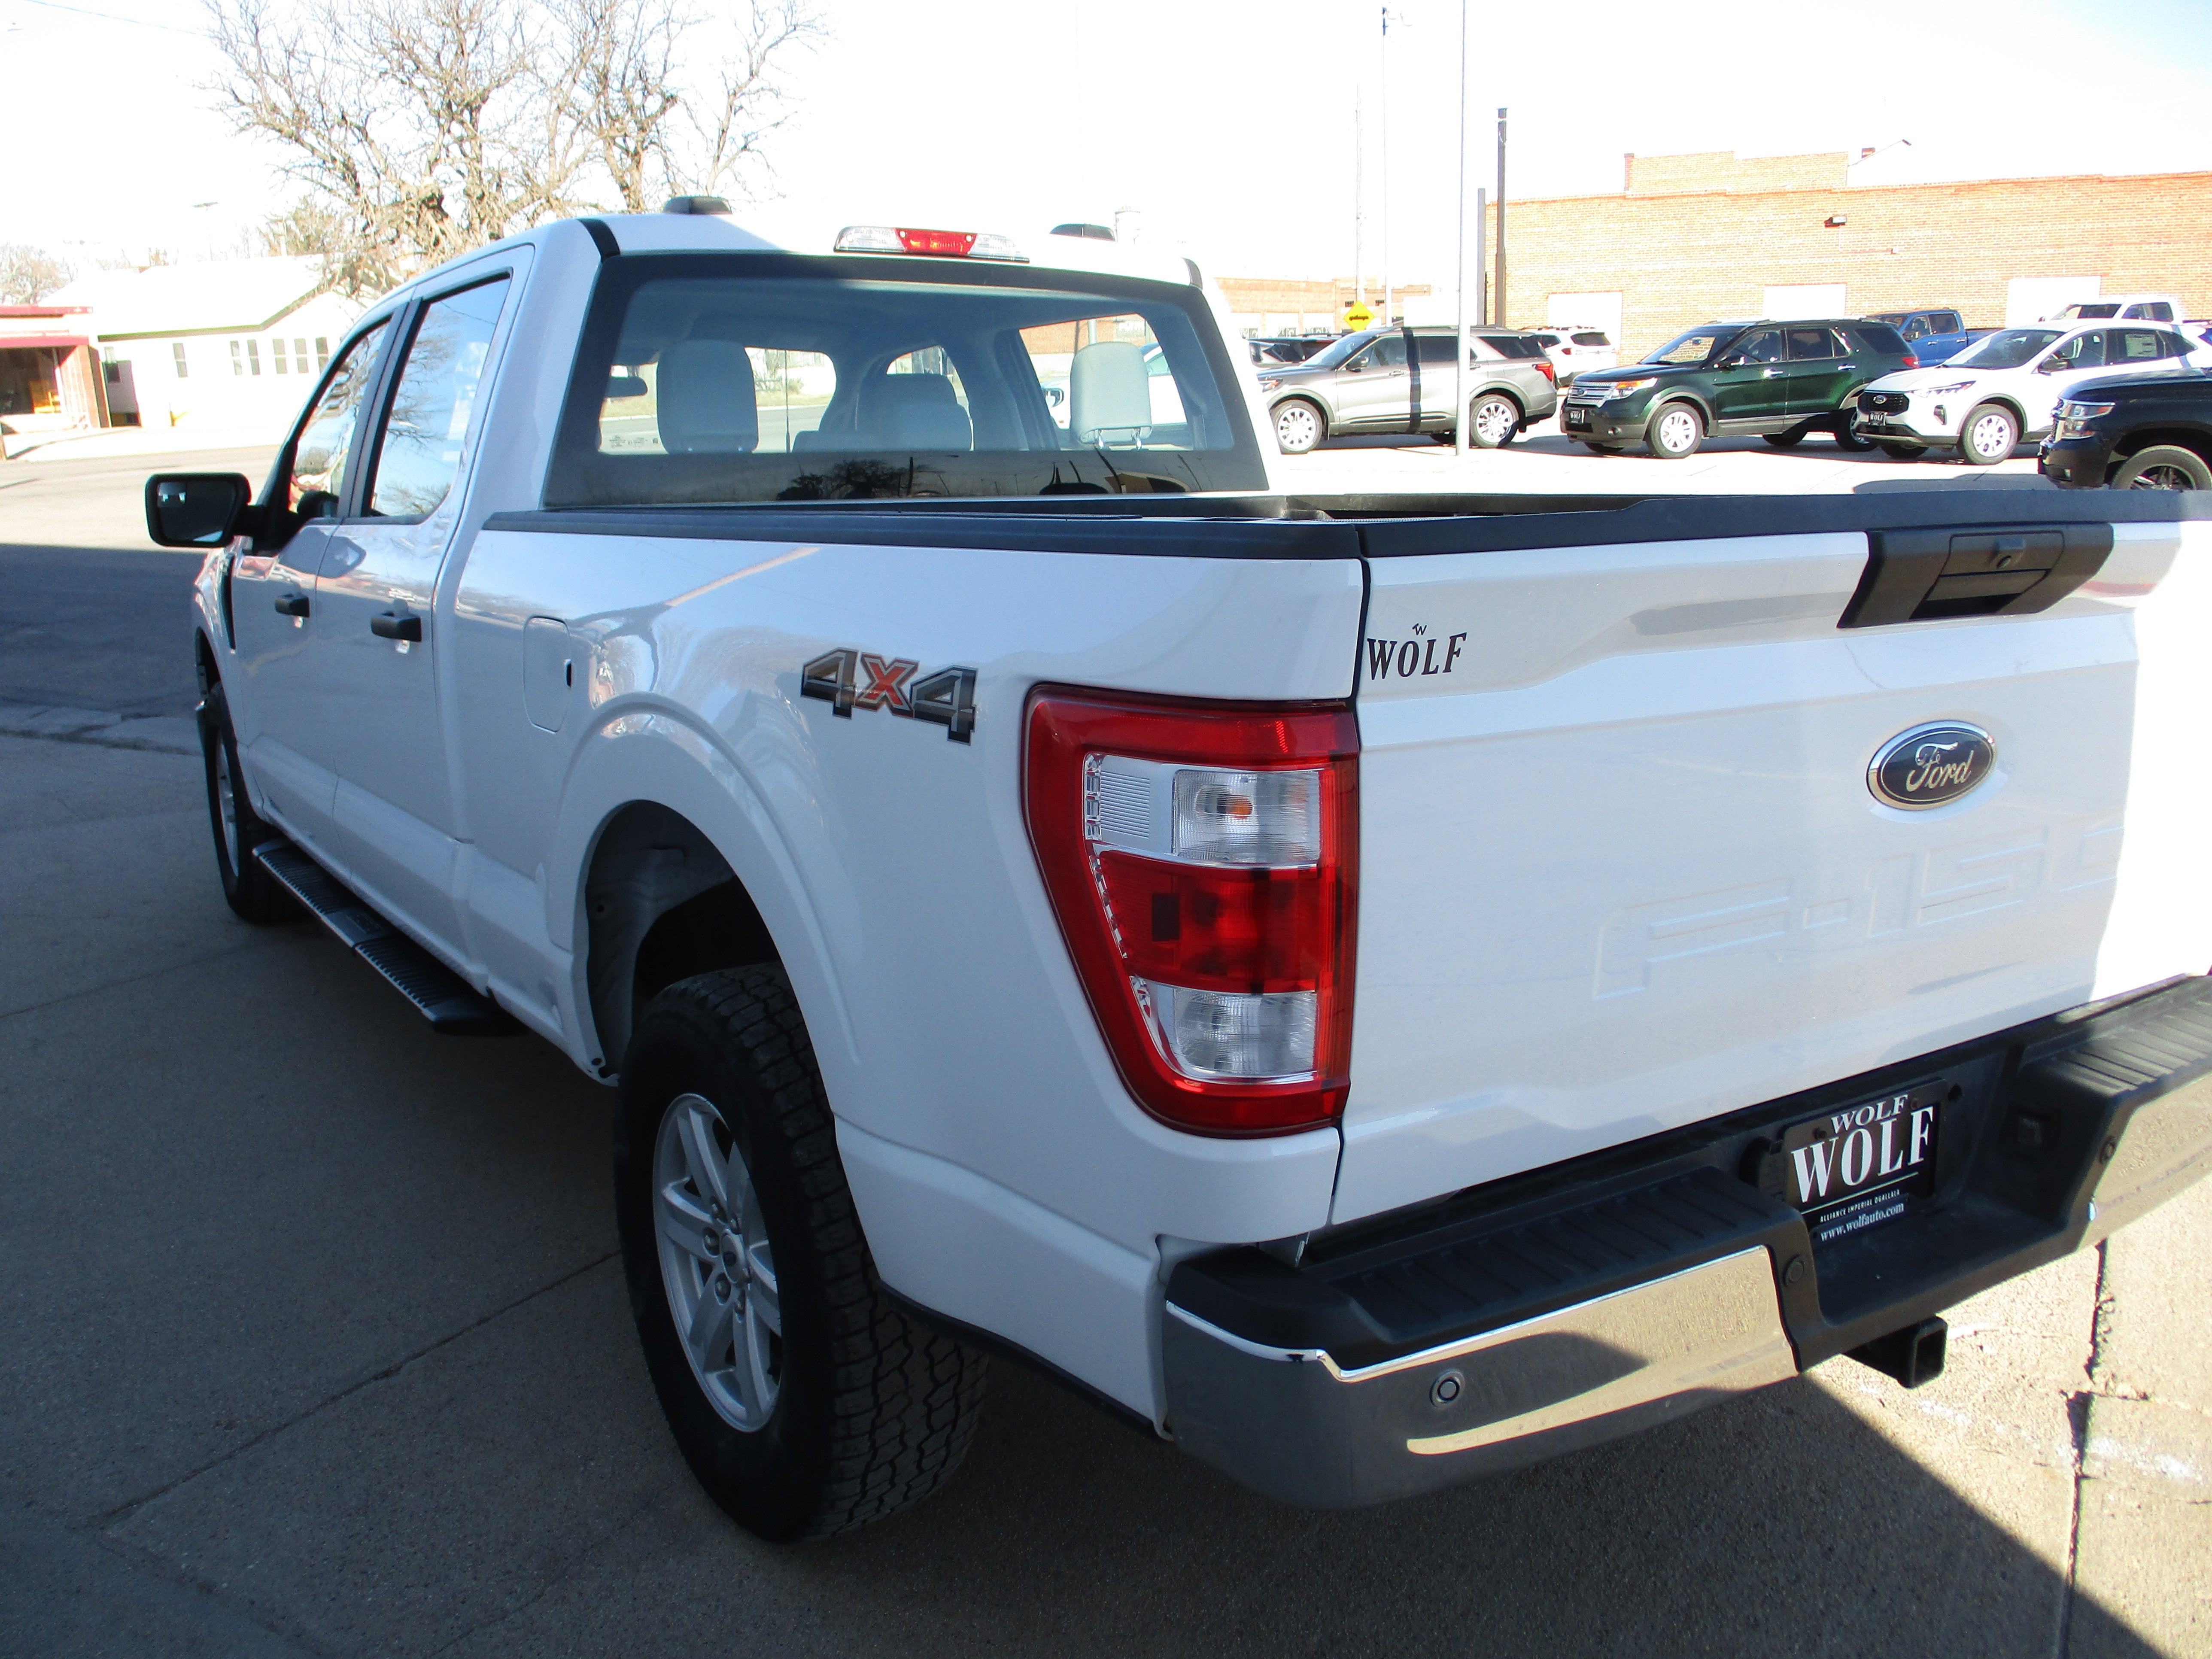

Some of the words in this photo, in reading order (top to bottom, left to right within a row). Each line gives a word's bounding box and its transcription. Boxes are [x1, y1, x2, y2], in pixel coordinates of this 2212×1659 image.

[1367, 632, 1467, 680] WOLF
[1905, 742, 1974, 792] Ford
[1830, 1094, 1908, 1134] WOLF
[1790, 1106, 1933, 1203] WOLF
[1820, 1207, 1846, 1223] ALLIANCE
[1847, 1198, 1873, 1213] IMPERIAL
[1874, 1188, 1900, 1203] OGALLALA
[1820, 1203, 1905, 1242] www.wolfauto.com
